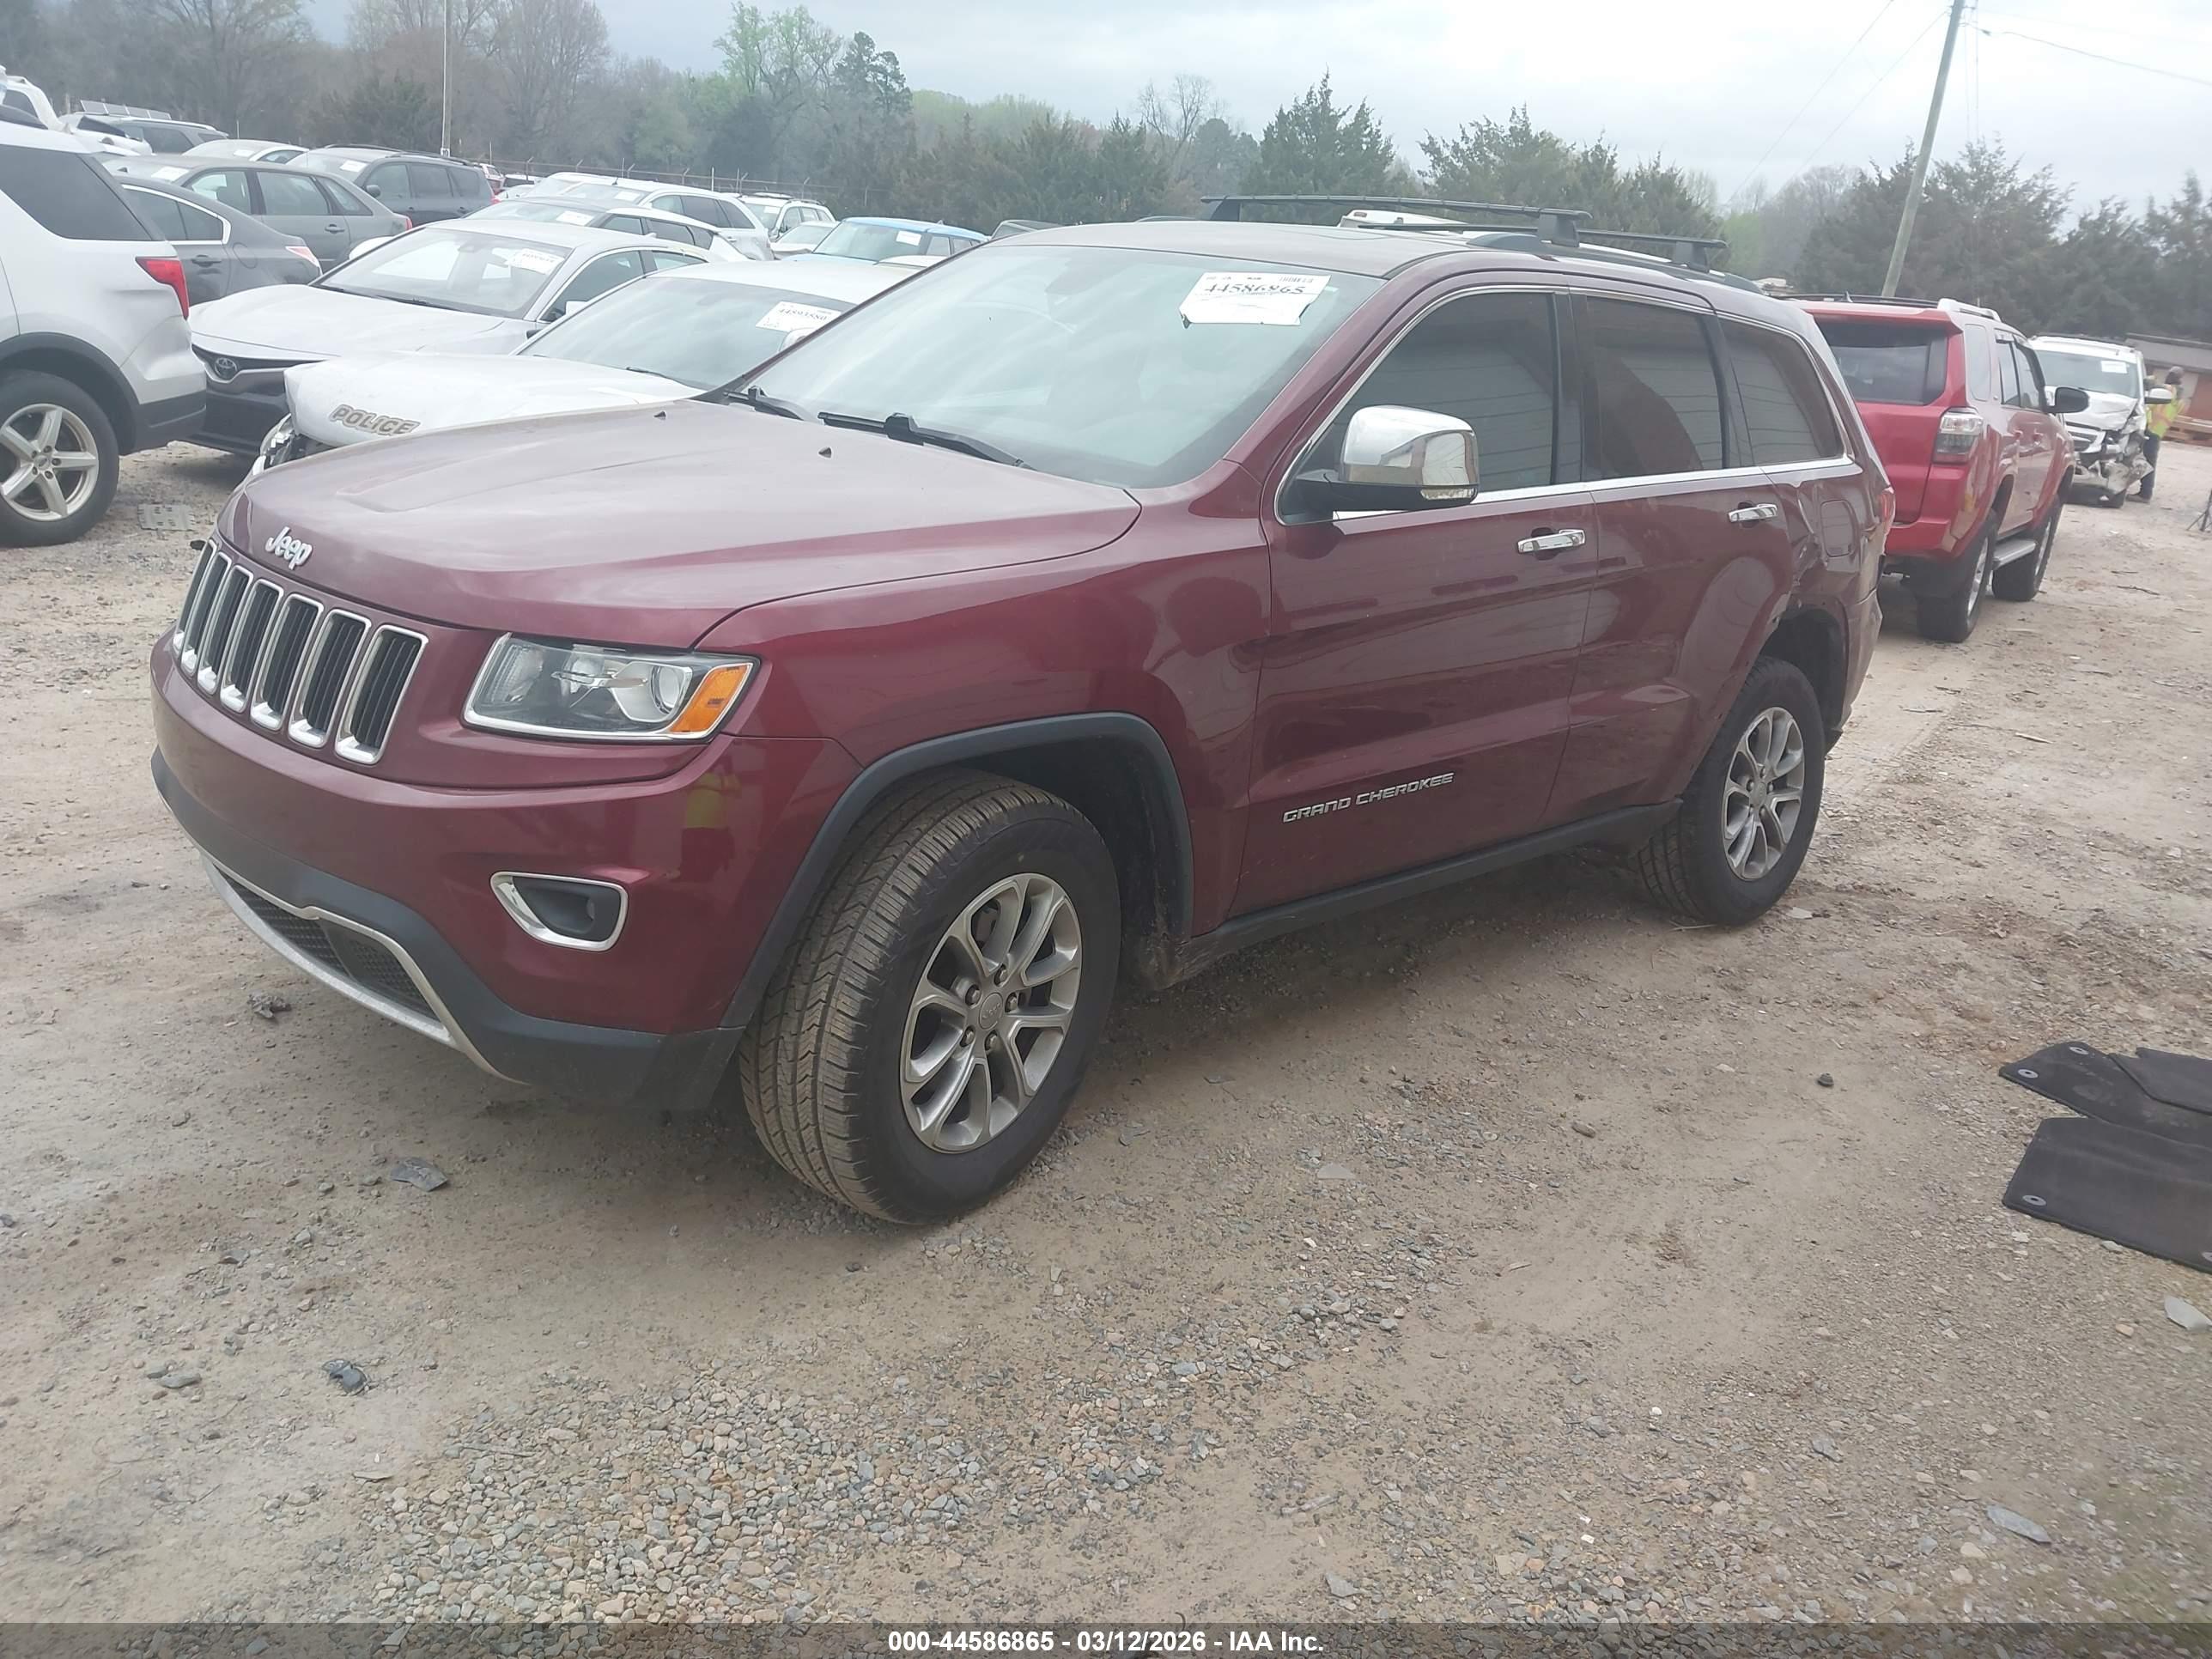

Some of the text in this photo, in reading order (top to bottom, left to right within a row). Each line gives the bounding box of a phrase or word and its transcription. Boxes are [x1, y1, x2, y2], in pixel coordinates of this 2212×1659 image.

[330, 404, 419, 434] POLICE
[264, 526, 313, 570] Jeep
[1283, 773, 1455, 823] GRAND CHEROKEE
